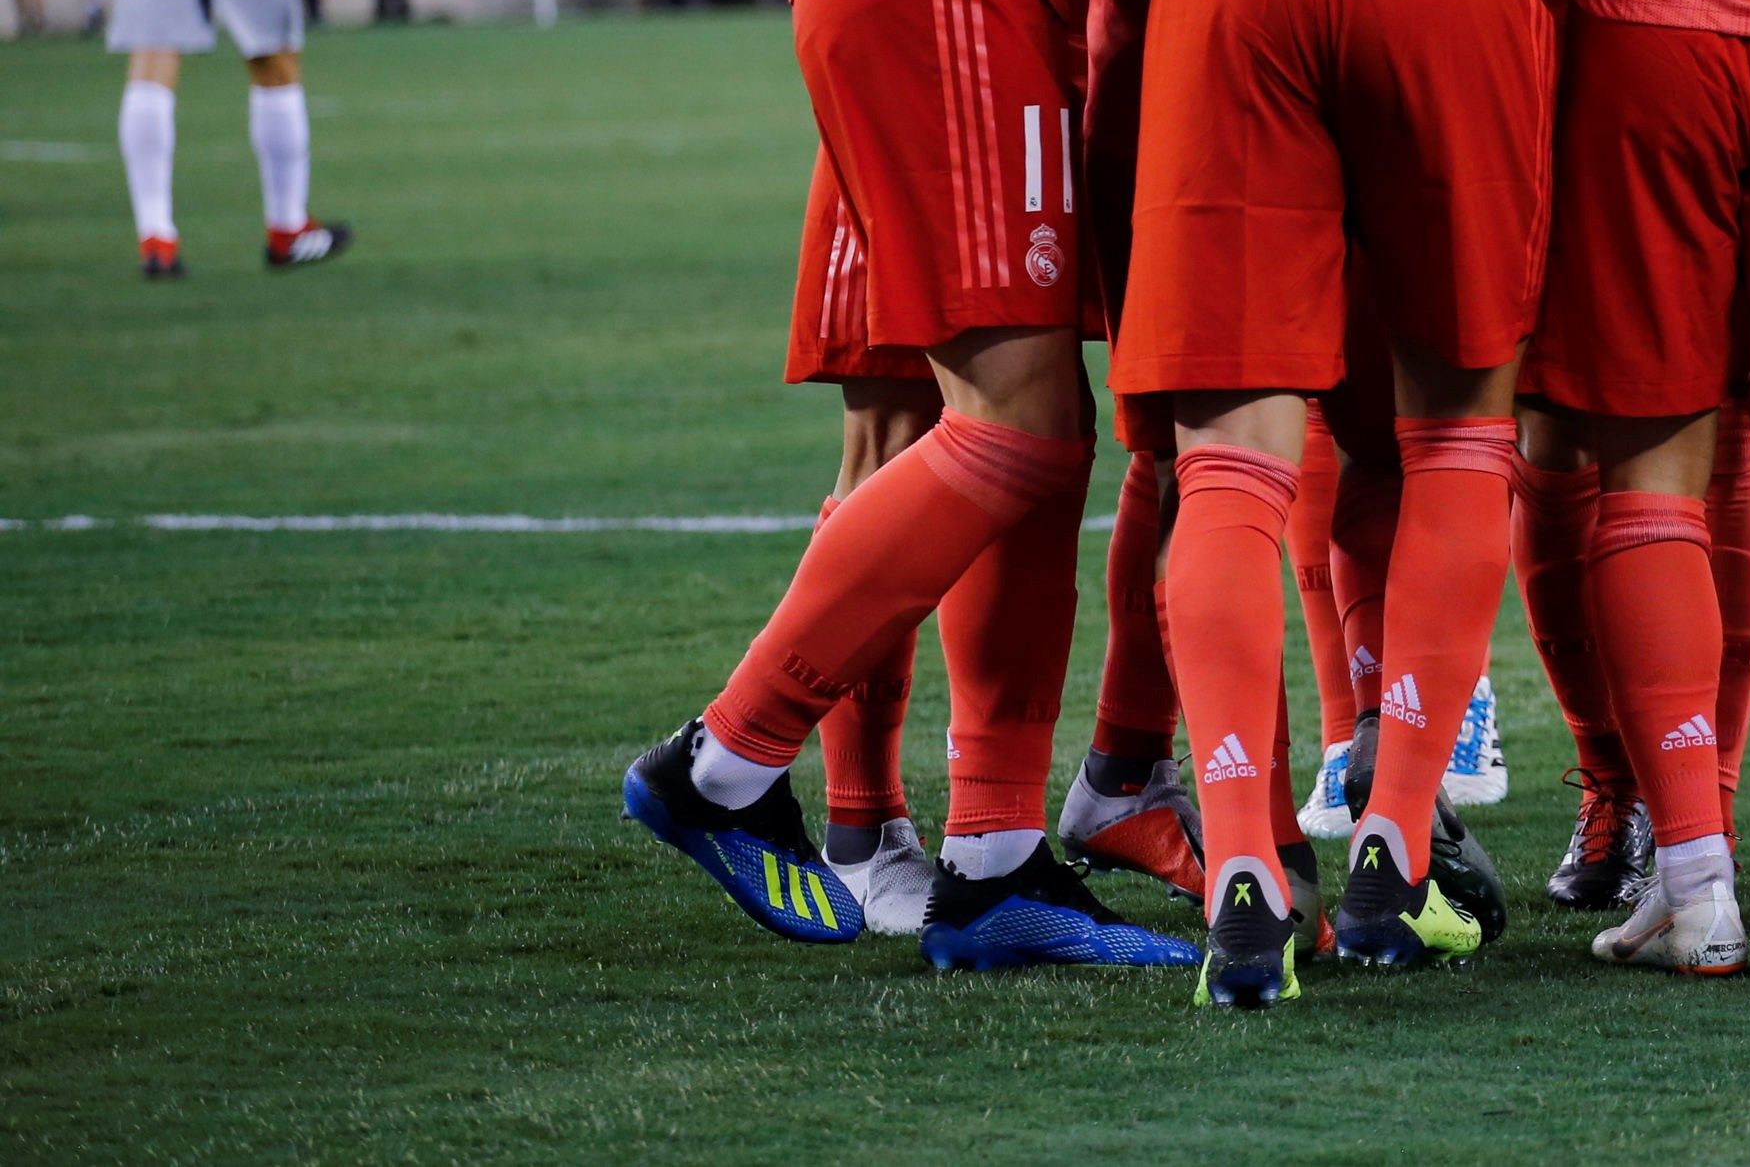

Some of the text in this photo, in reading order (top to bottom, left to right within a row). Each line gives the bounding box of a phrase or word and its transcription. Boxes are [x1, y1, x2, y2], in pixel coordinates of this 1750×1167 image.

[1024, 105, 1073, 213] 11
[1381, 700, 1427, 729] adidas
[1661, 733, 1717, 750] adidas
[1204, 763, 1257, 784] adidas
